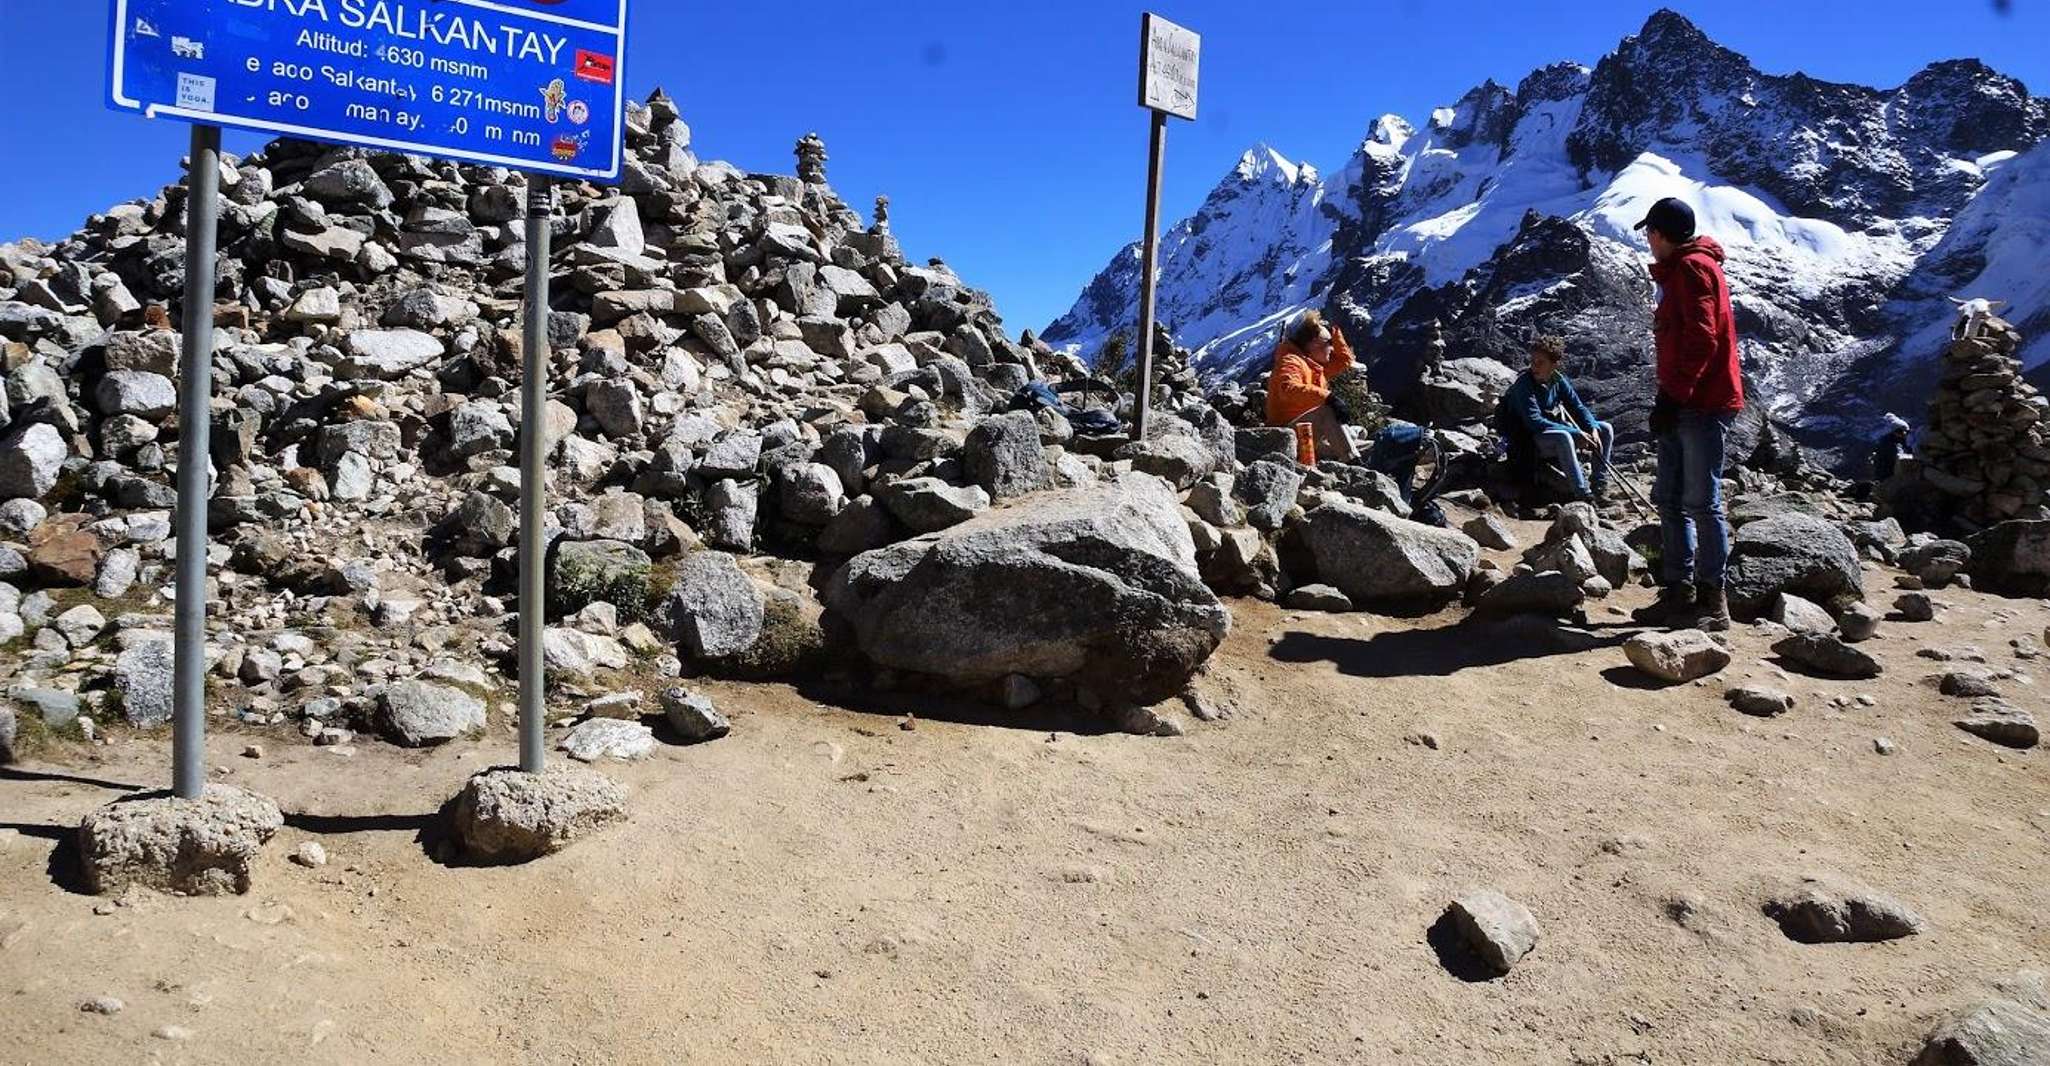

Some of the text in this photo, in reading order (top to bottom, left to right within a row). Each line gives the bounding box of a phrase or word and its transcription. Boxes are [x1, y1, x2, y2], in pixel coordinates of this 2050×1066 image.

[296, 29, 368, 58] Altitud:
[430, 57, 488, 80] msnm
[339, 0, 567, 65] SALKANTAY
[485, 125, 540, 146] mnm
